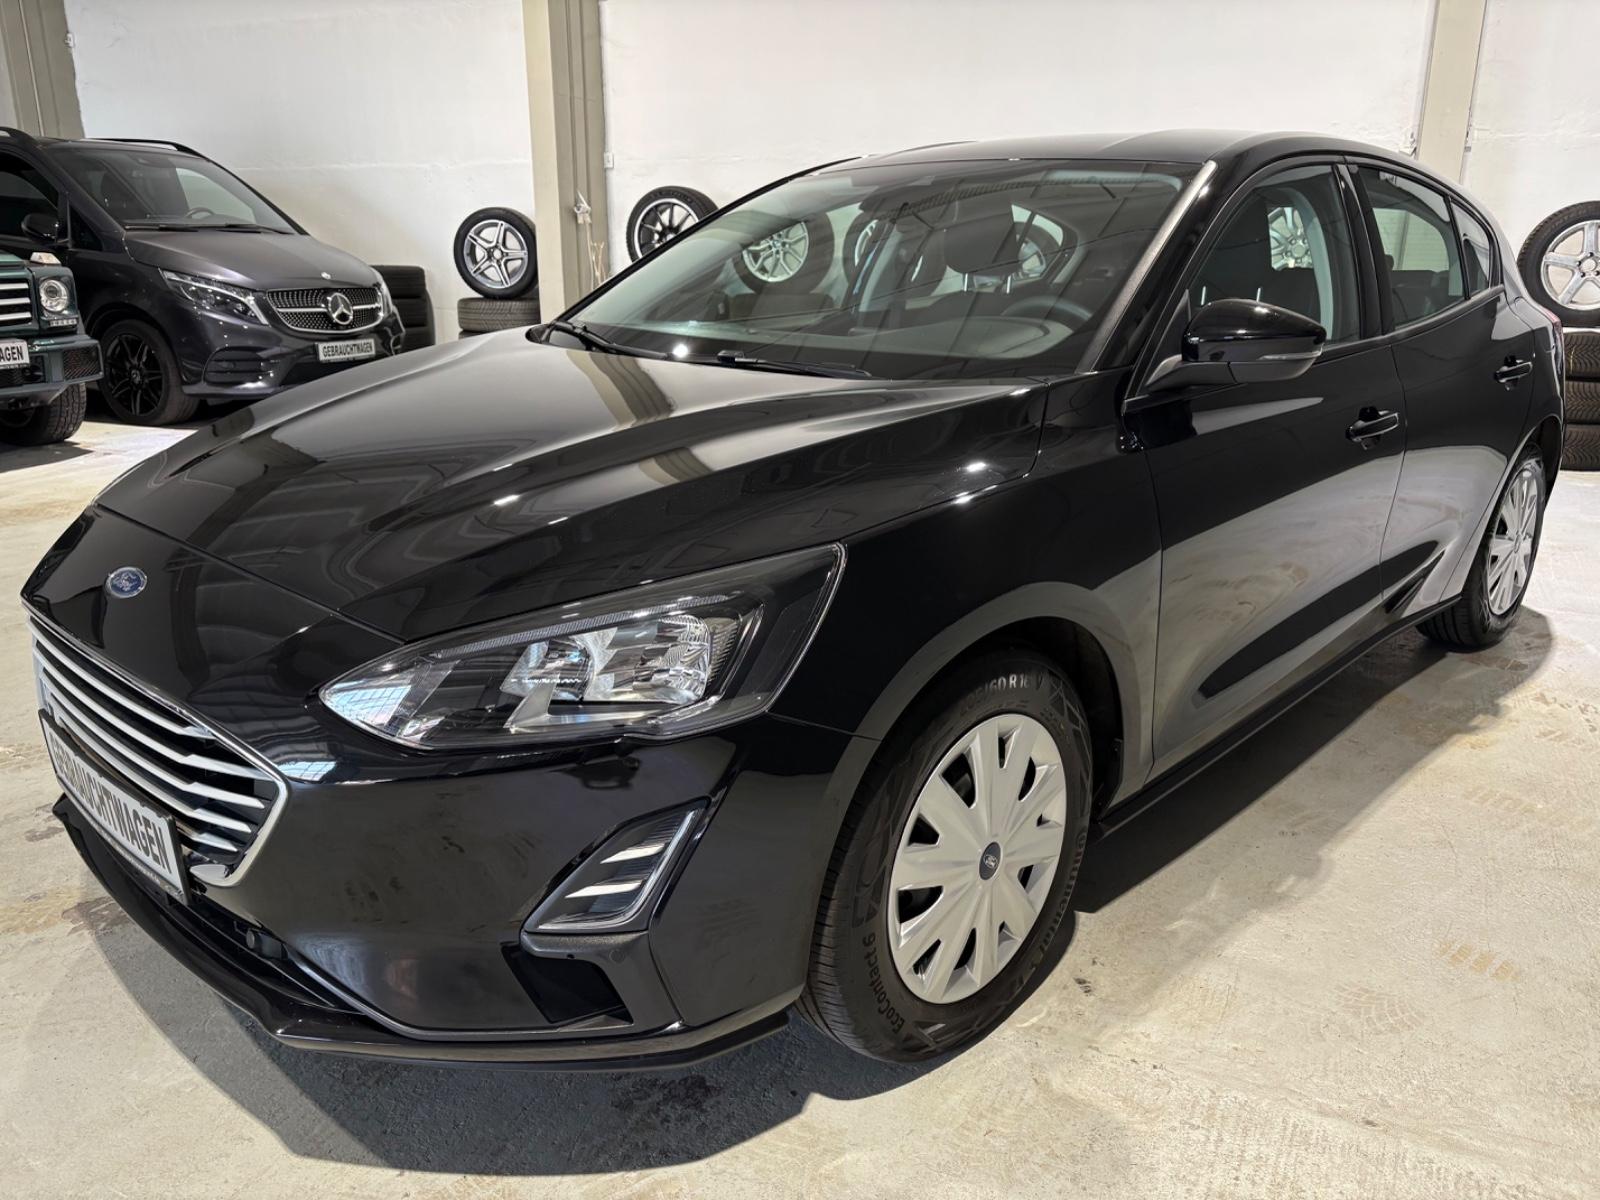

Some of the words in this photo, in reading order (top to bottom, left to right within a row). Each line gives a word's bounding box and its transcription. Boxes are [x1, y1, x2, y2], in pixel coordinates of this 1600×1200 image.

[49, 731, 172, 875] GEBRAUCHTWAGEN
[862, 932, 875, 947] 6
[864, 947, 905, 1034] EcoContact
